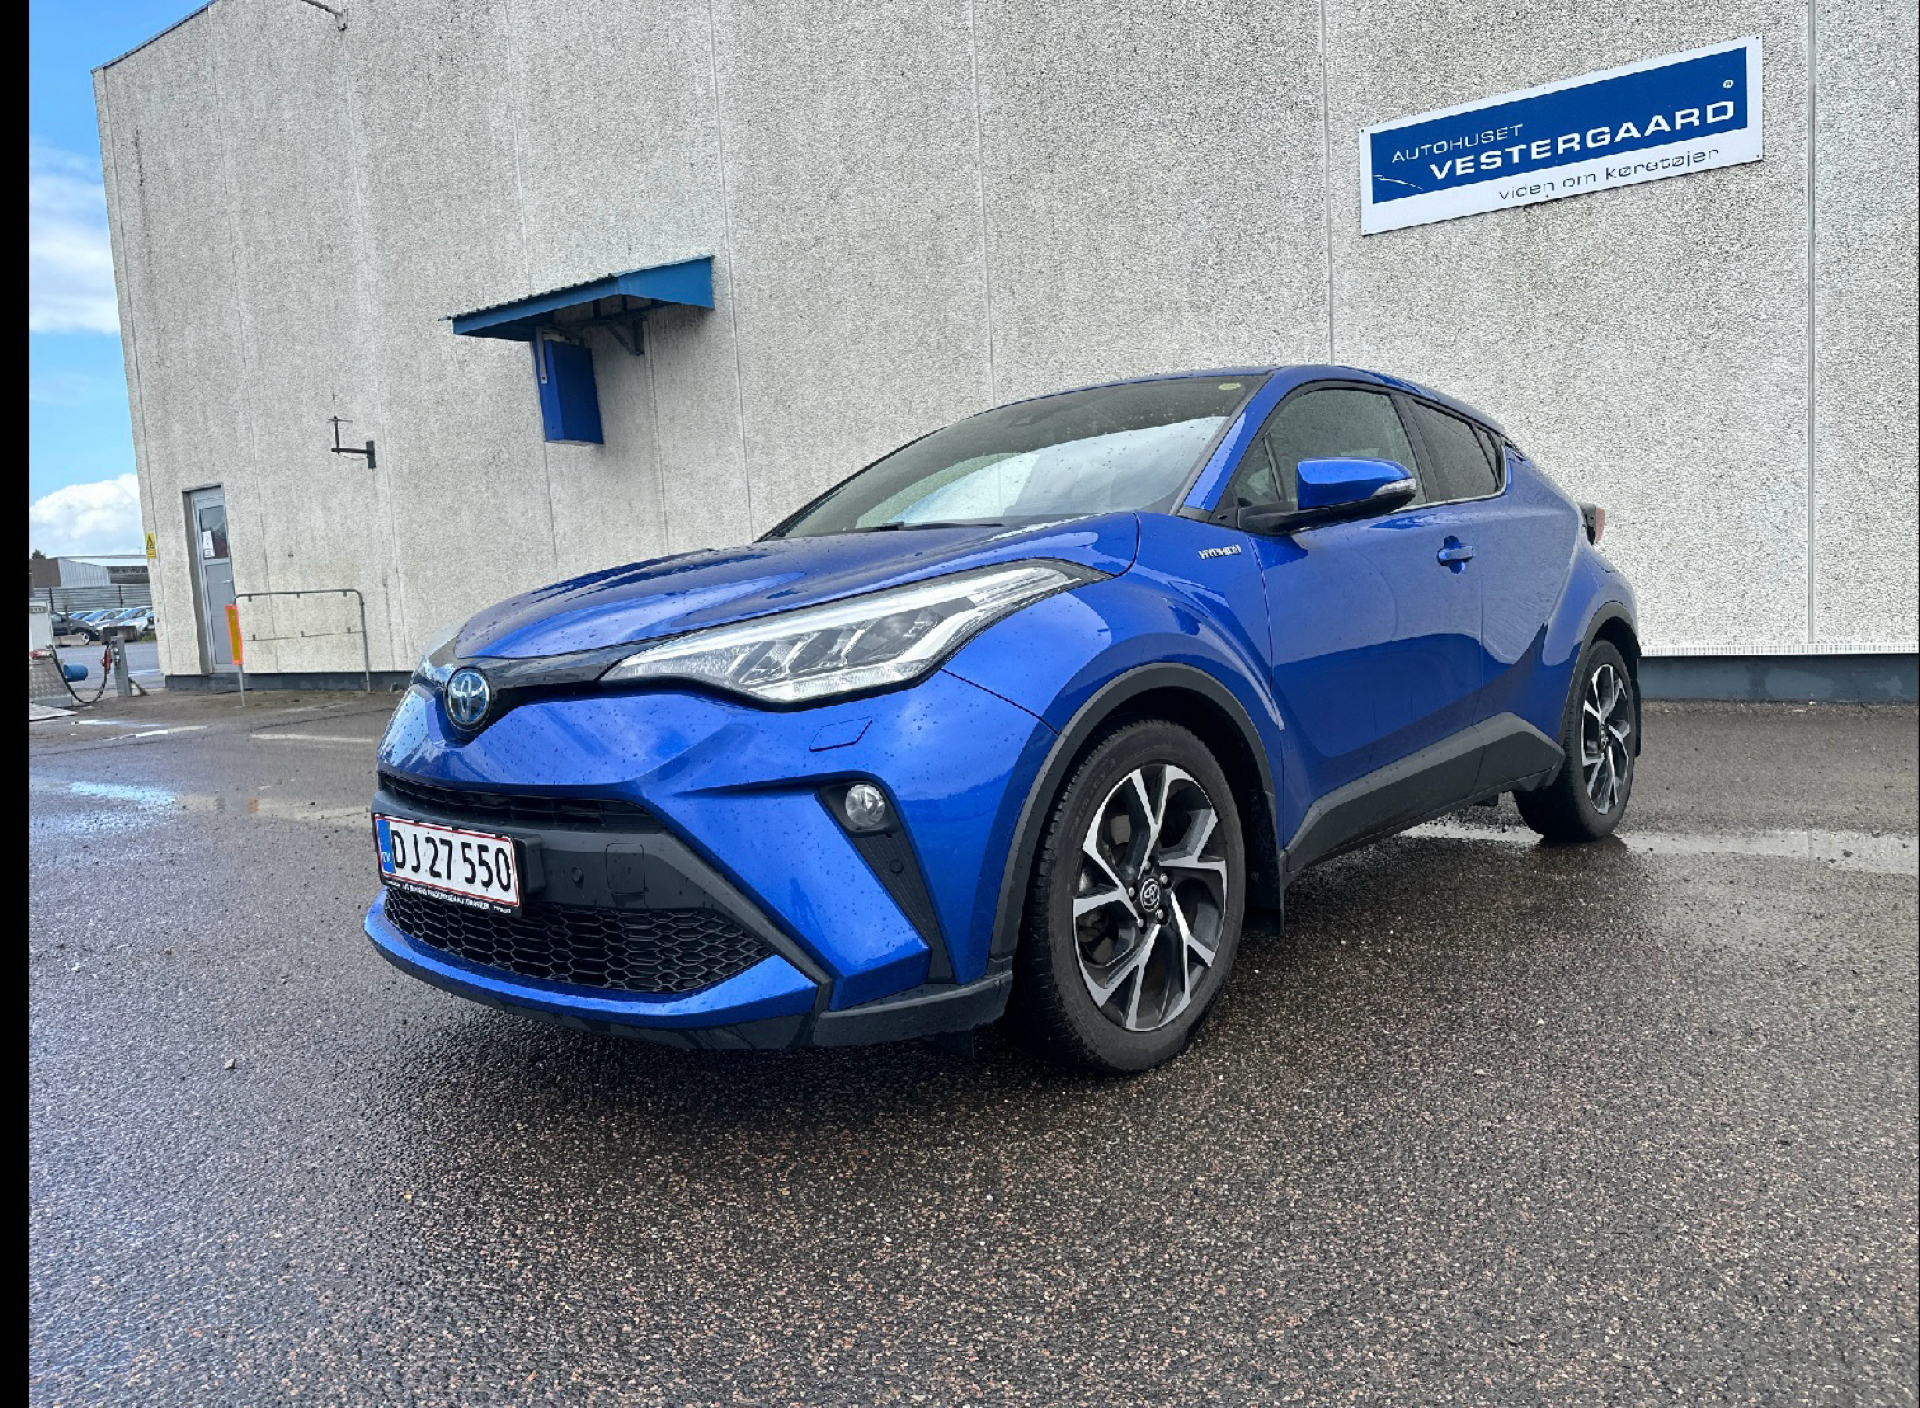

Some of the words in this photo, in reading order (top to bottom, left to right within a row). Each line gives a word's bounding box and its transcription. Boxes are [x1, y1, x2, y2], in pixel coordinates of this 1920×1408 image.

[1392, 123, 1523, 163] AUTOHUSET
[1429, 101, 1734, 180] VESTERGAARD
[1500, 182, 1555, 200] viden
[1562, 173, 1596, 187] om
[1605, 149, 1719, 181] køretøjer
[461, 841, 511, 892] 550
